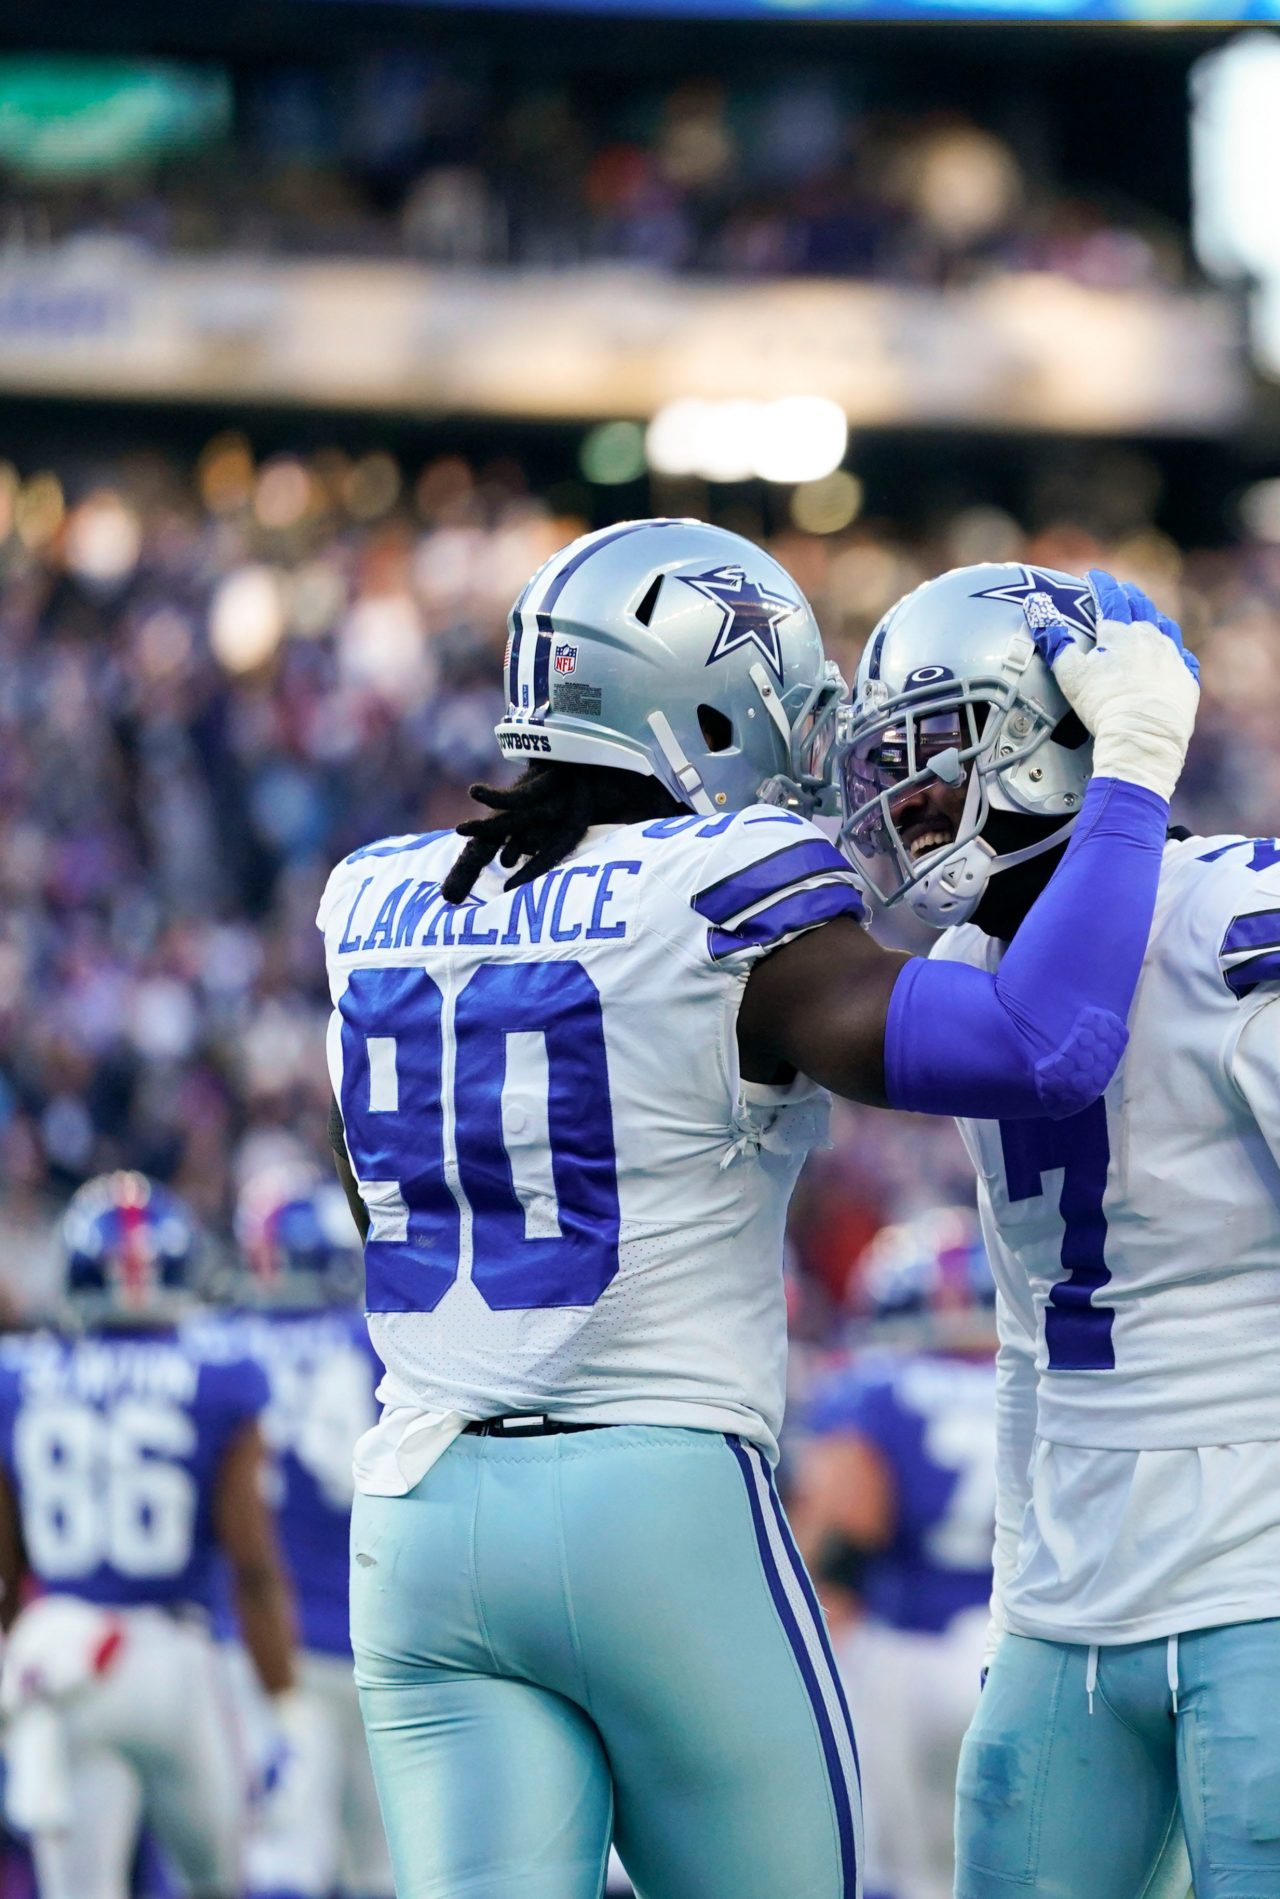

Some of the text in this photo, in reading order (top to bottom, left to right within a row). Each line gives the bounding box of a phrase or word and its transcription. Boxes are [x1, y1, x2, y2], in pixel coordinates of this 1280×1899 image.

[555, 656, 574, 672] NFL
[338, 960, 621, 1313] 90
[998, 1094, 1116, 1370] 7
[13, 1399, 198, 1578] 86
